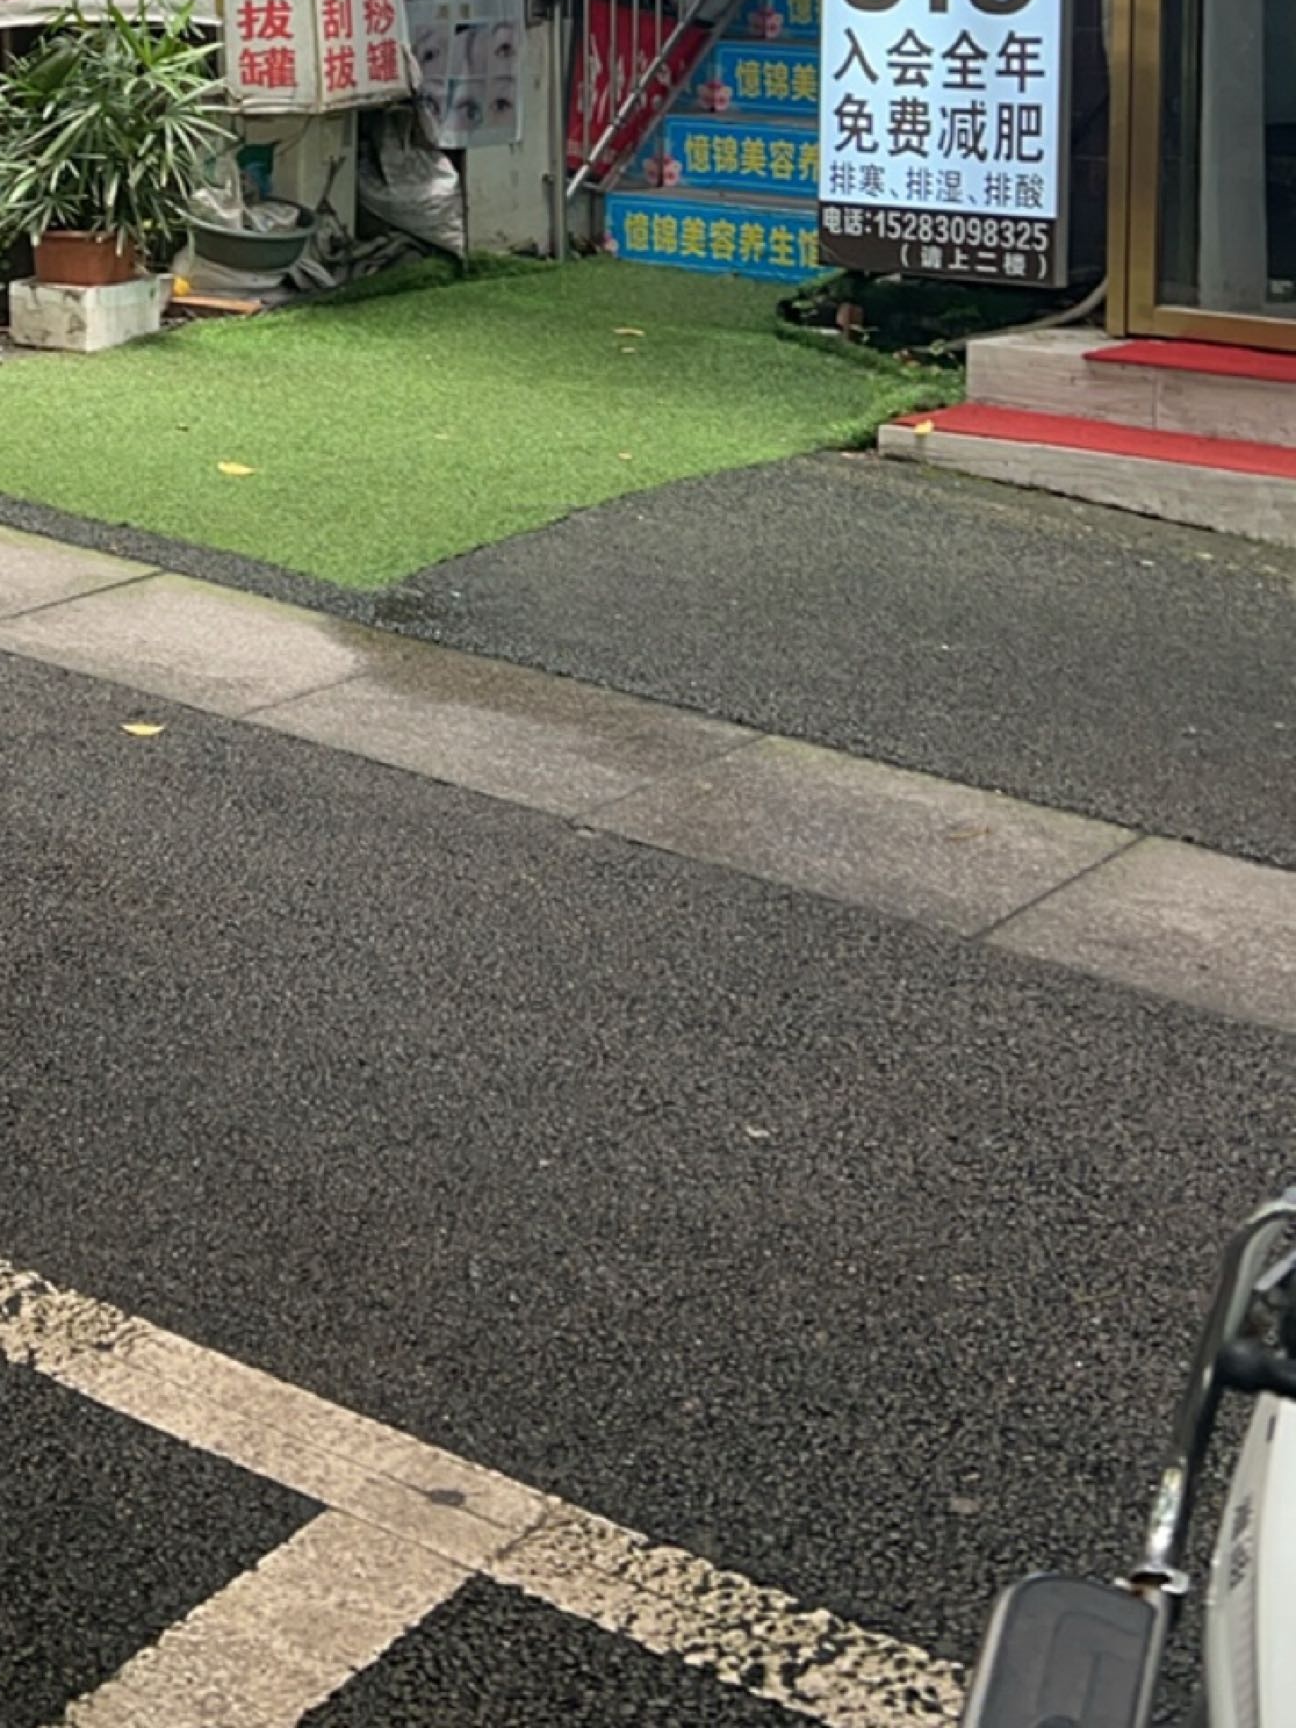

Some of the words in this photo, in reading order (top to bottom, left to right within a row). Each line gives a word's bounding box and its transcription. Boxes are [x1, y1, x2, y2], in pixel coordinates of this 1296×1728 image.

[833, 27, 1046, 95] 入会全年
[833, 93, 1045, 164] 免费减肥
